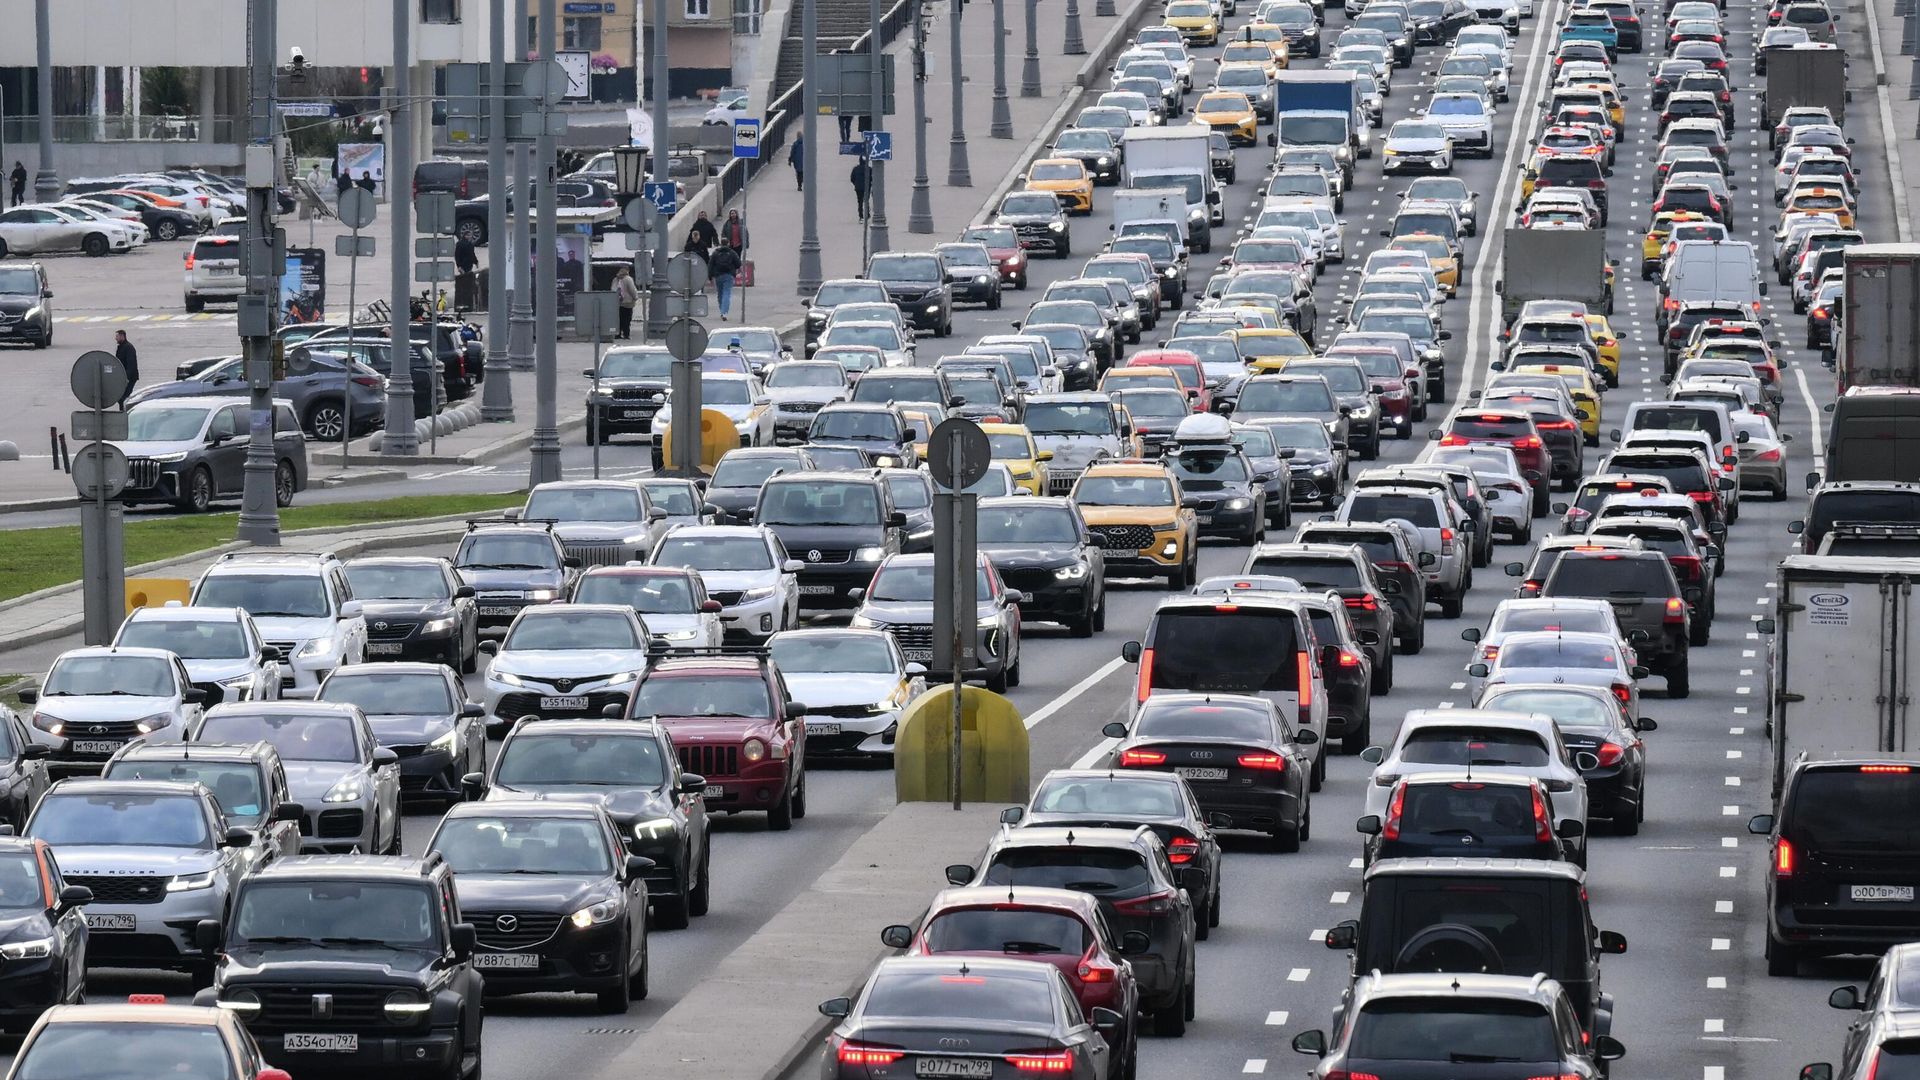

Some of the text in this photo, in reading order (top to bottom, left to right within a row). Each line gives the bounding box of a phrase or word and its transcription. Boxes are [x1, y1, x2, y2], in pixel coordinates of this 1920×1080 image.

[75, 743, 111, 751] М191СХ
[87, 916, 132, 927] 61УК 799
[477, 954, 536, 966] У887СТ 777
[288, 1035, 355, 1048] А354ОТ 797
[920, 1060, 989, 1073] Р077ТМ 799
